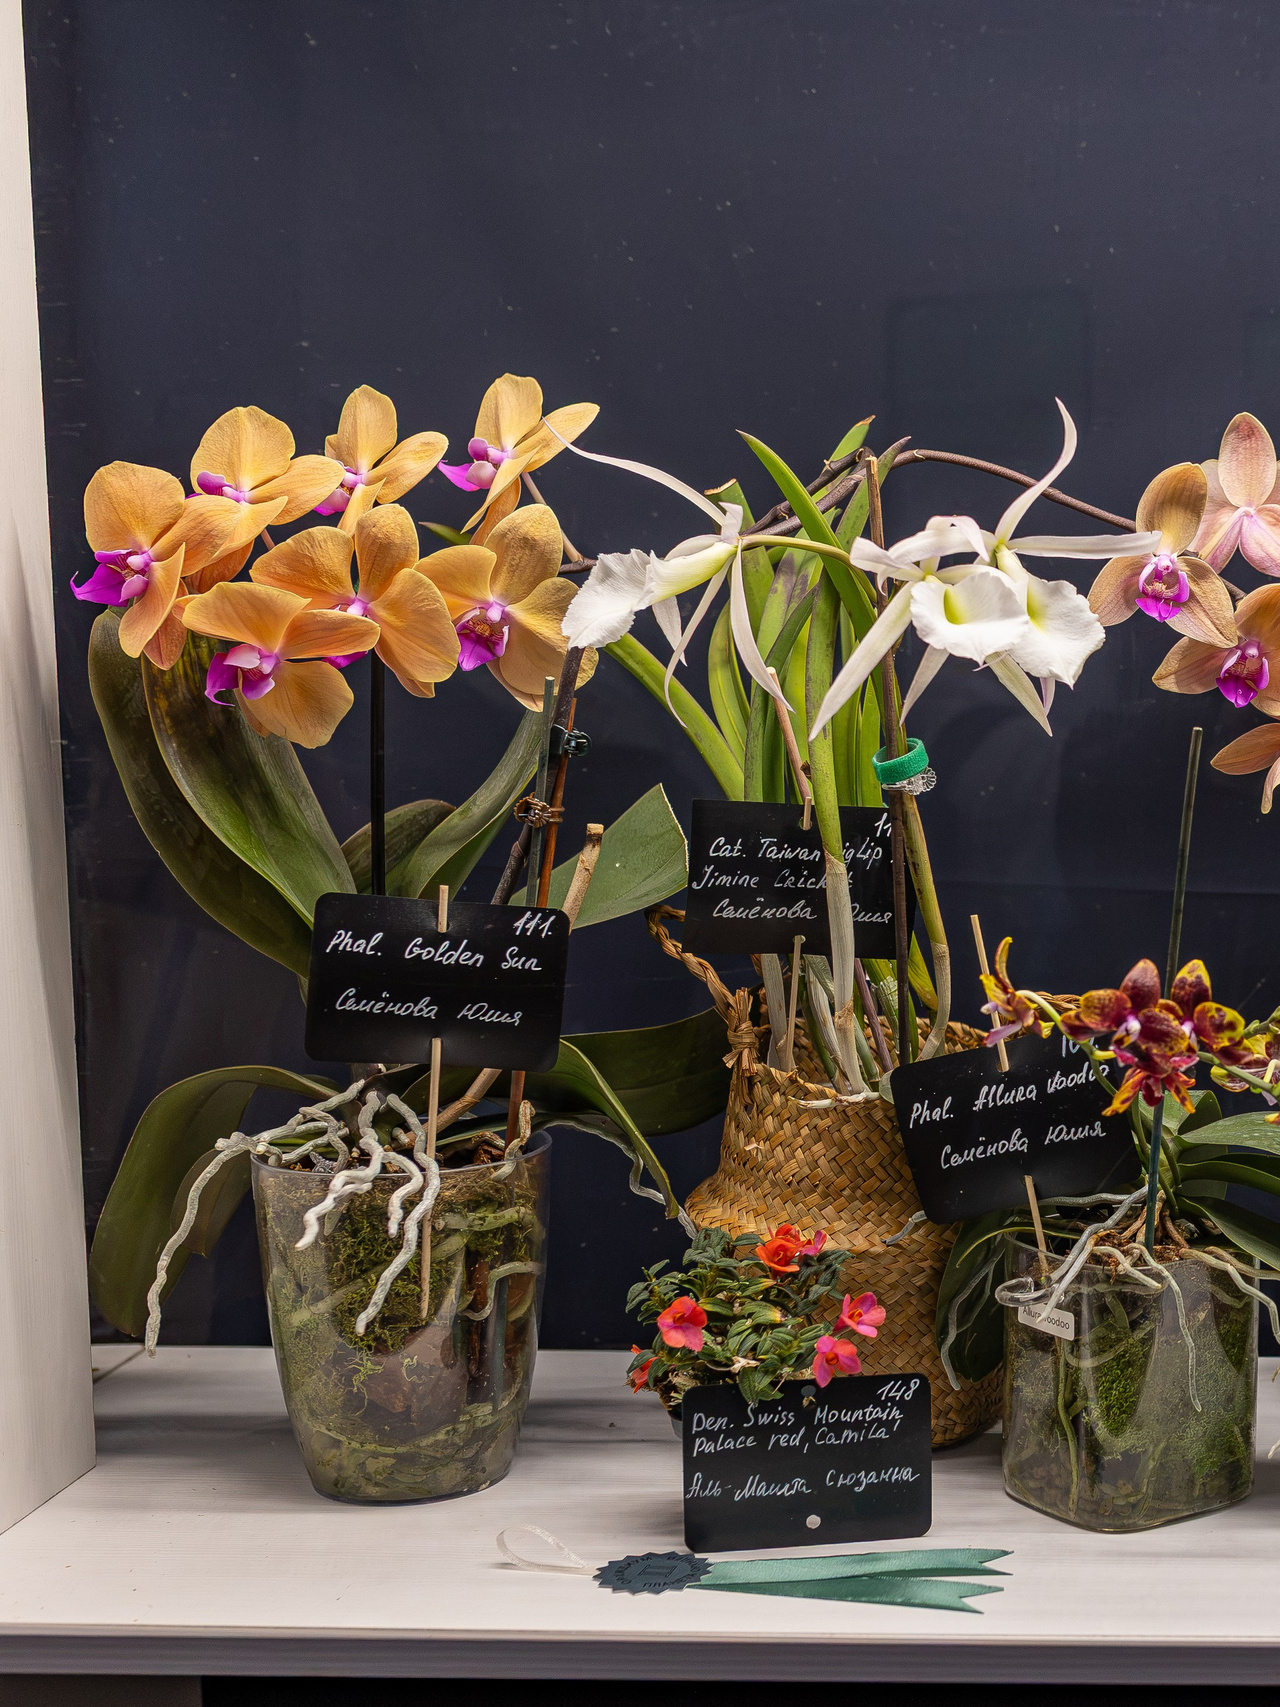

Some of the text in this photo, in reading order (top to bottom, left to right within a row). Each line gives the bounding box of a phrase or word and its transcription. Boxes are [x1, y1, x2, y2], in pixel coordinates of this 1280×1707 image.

[709, 837, 883, 869] Cat. Taiwan igLip
[774, 868, 854, 889] Crickt
[712, 897, 818, 920] Семёнова
[326, 930, 542, 971] Phal. Golden Sun
[335, 987, 523, 1026] Семёнова Юлия
[909, 1097, 954, 1129] Phal.
[973, 1083, 1037, 1112] Allura
[940, 1121, 1107, 1169] Семёнова Юлия
[1044, 1316, 1070, 1330] oodoo
[876, 1378, 920, 1401] 148
[692, 1412, 734, 1434] Den.
[743, 1402, 795, 1428] Swiss
[768, 1426, 809, 1454] red,
[826, 1466, 920, 1492] Сюзанна
